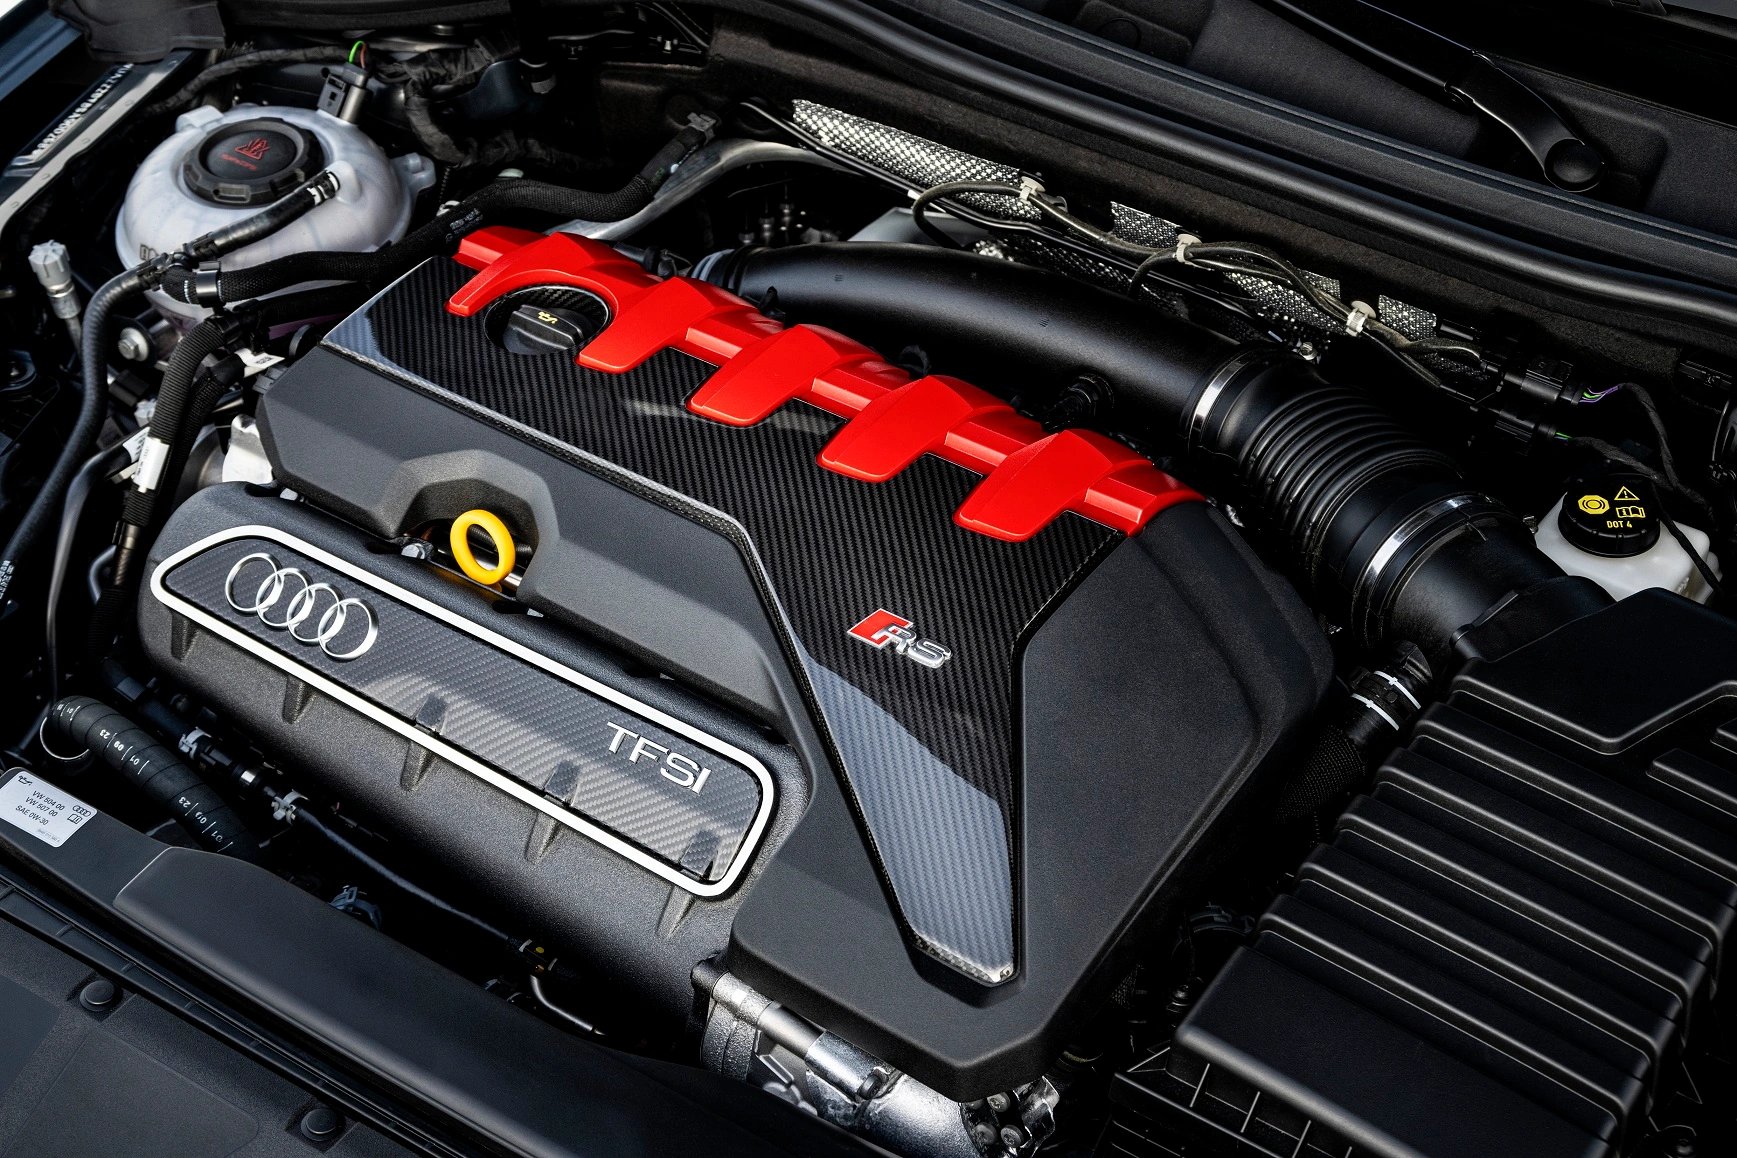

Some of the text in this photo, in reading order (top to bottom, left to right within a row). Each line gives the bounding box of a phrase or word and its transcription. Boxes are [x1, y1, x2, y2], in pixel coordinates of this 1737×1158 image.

[1606, 520, 1633, 528] DOT 4
[868, 621, 952, 669] RS
[99, 729, 111, 739] 23
[130, 755, 140, 765] 01
[606, 721, 712, 794] TFSI
[25, 796, 59, 817] VW 507 00
[32, 790, 65, 811] VW 504 00
[178, 796, 191, 808] 23
[15, 805, 49, 826] SAE 0W-30
